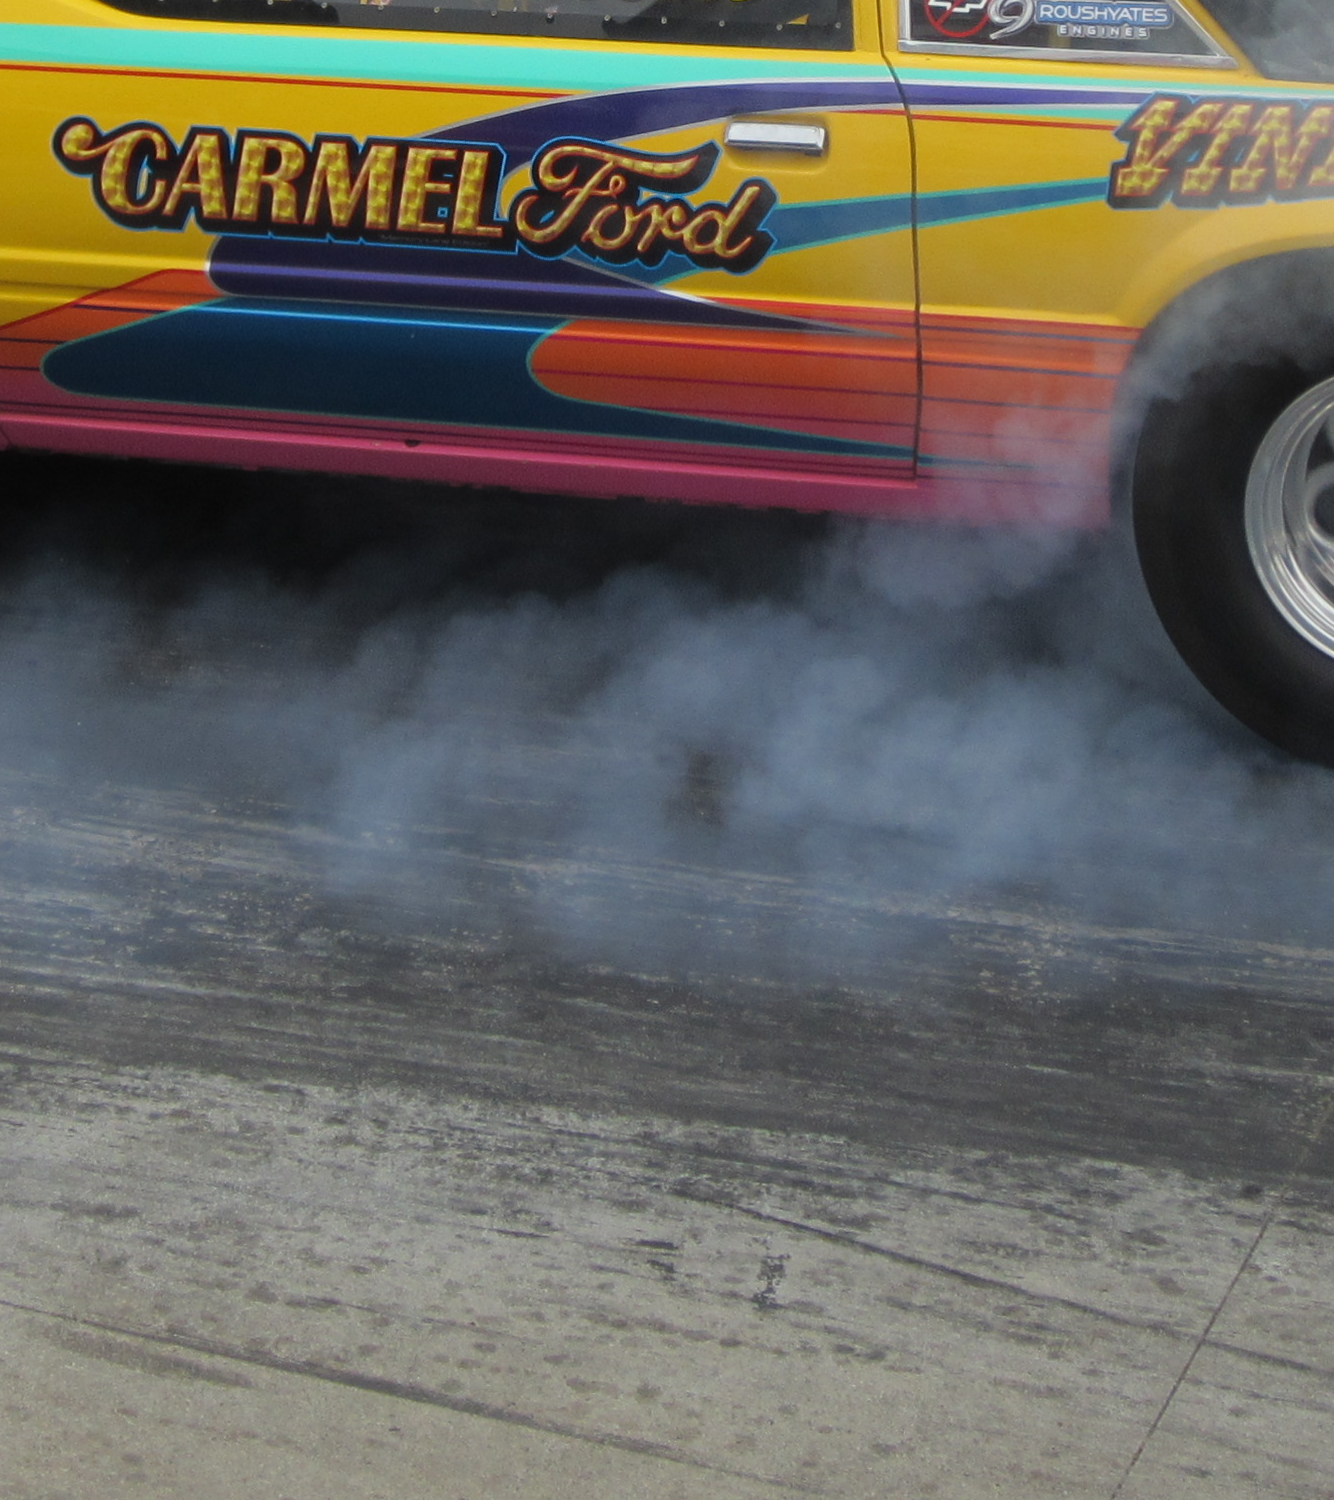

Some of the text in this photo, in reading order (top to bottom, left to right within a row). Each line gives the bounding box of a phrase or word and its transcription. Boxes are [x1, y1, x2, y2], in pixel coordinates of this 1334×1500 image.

[1039, 3, 1169, 23] ROUSHYATES
[1059, 26, 1149, 38] ENGINES
[59, 122, 766, 261] CARMEL Ford
